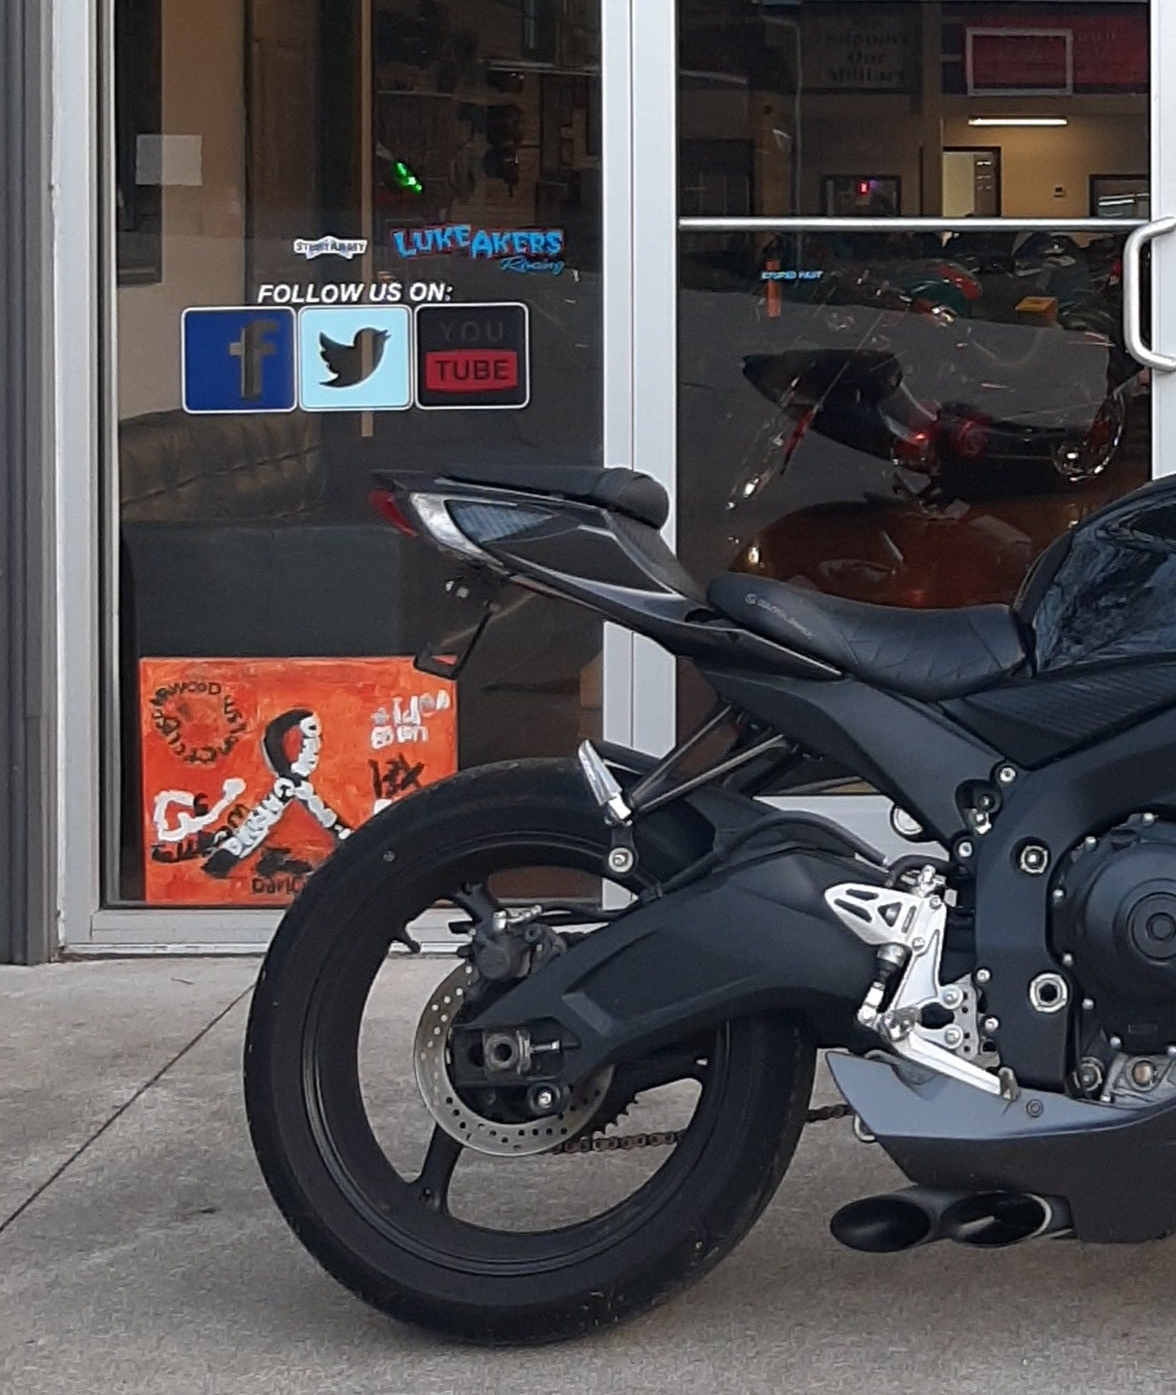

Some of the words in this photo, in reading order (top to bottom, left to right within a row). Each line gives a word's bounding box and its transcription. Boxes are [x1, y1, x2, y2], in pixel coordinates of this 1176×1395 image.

[393, 223, 472, 259] LUKE
[470, 228, 565, 260] AKERS
[257, 283, 364, 304] FOLLOW
[369, 283, 402, 303] US
[409, 282, 454, 302] ON:
[439, 319, 504, 343] YOU
[434, 359, 509, 381] TUBE
